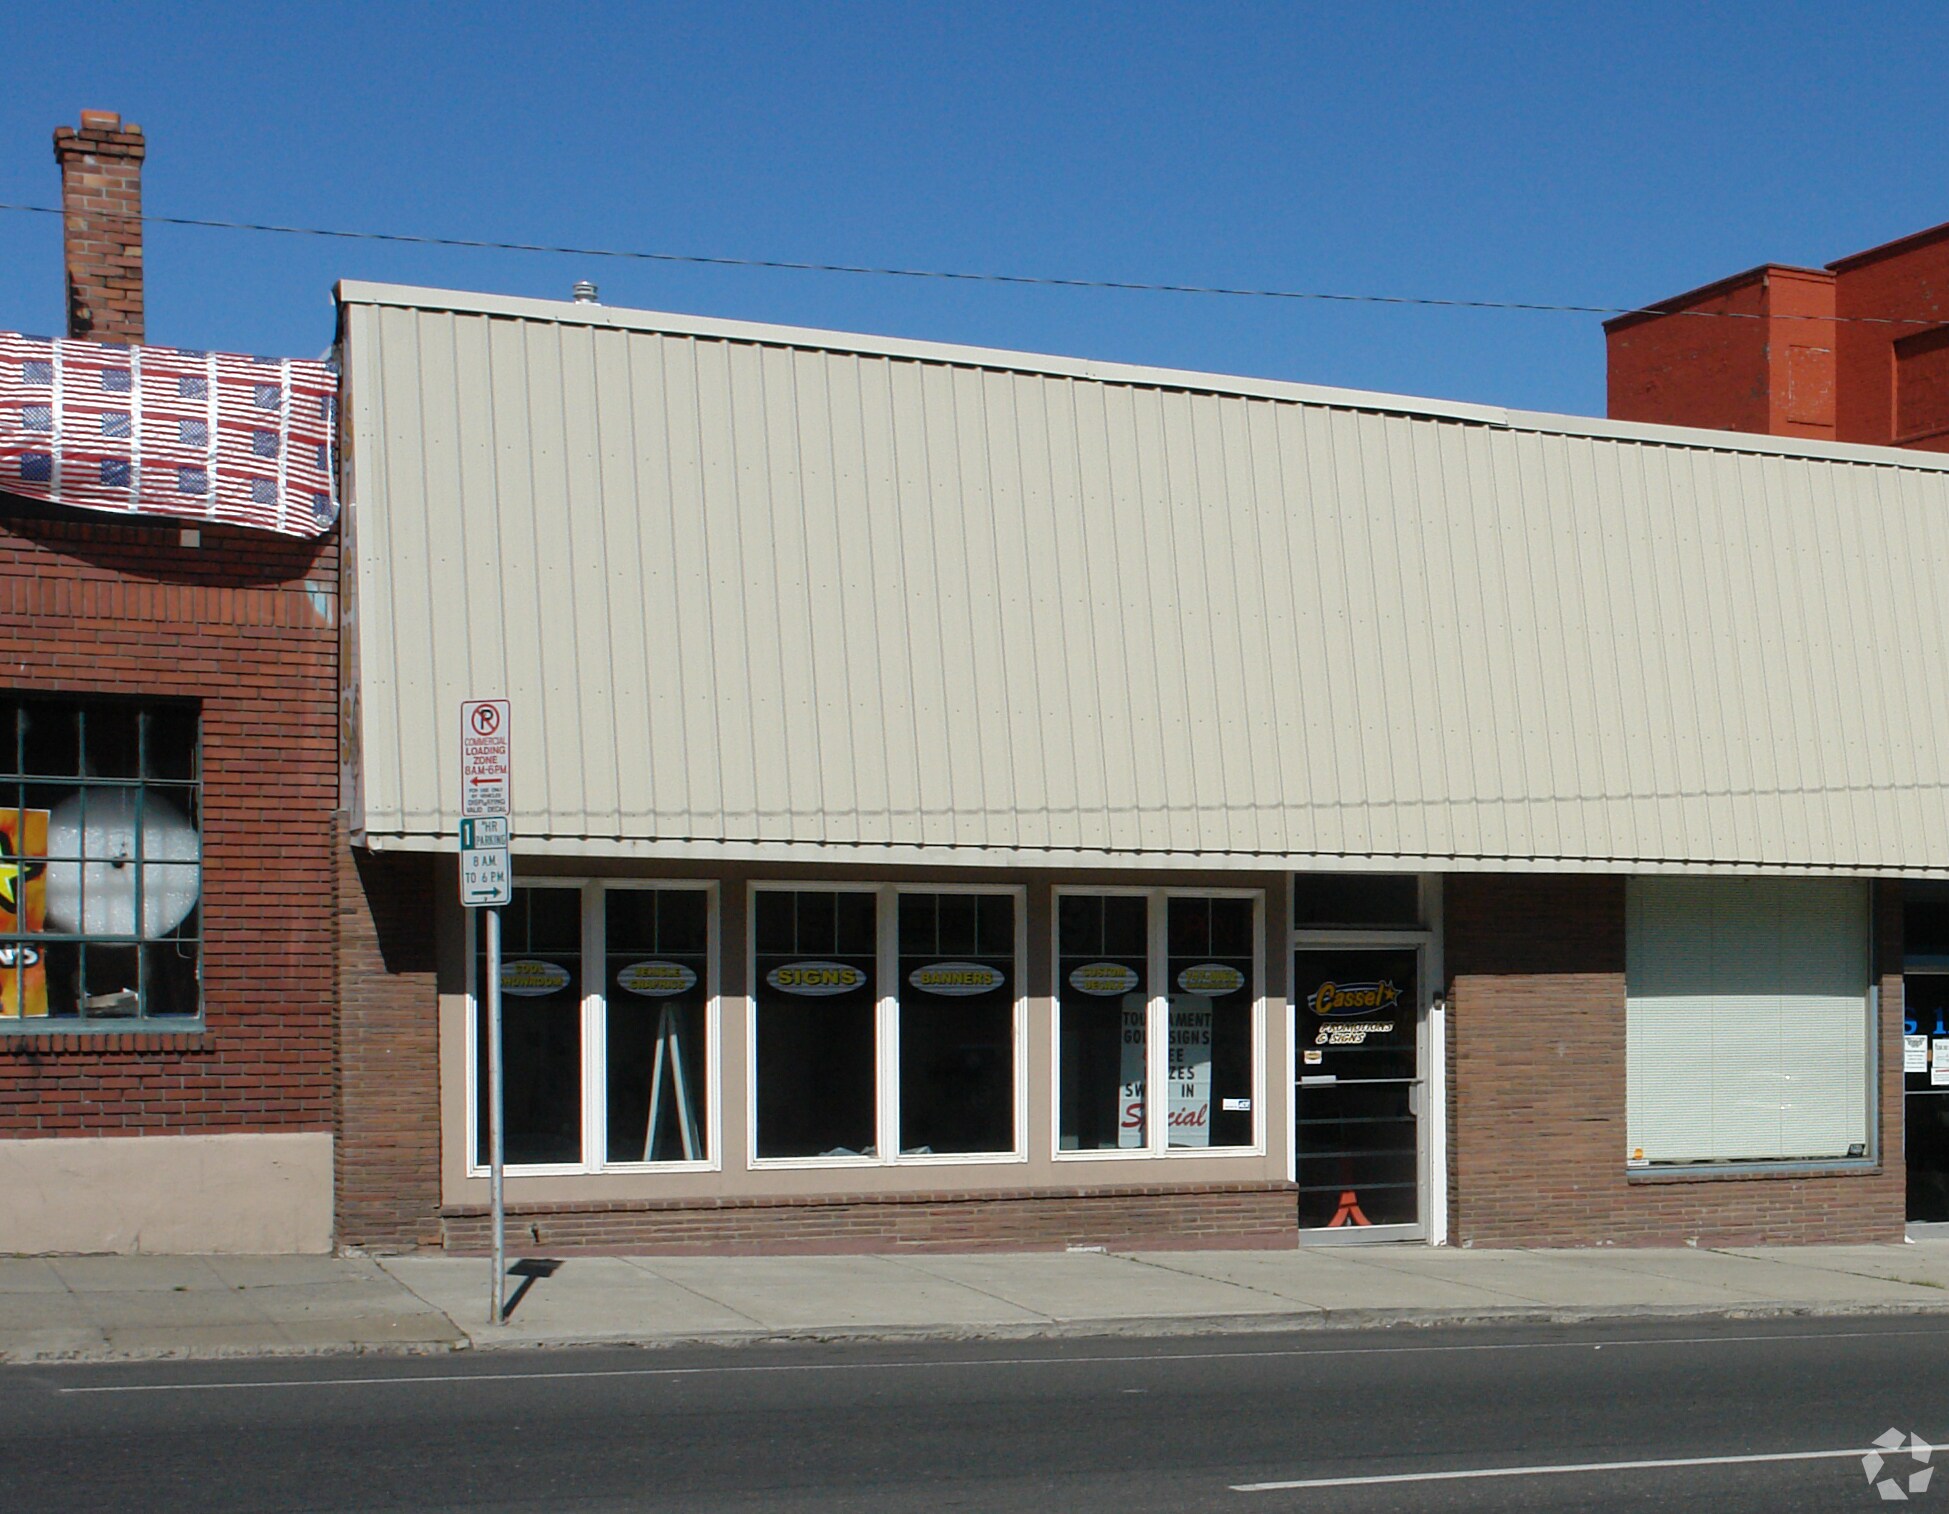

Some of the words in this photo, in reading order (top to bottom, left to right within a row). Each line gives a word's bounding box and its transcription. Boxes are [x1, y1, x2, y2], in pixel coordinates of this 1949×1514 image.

[465, 736, 507, 746] COMMERCIAL
[466, 746, 506, 756] LOADING
[473, 756, 498, 765] ZONE
[485, 820, 498, 833] HR
[463, 824, 471, 847] 1
[475, 834, 506, 847] PARKING
[473, 855, 480, 868] 8
[465, 872, 477, 884] TO
[482, 872, 488, 884] 6
[776, 967, 859, 987] SIGNS
[1083, 966, 1128, 978] CUSTOM
[629, 978, 687, 990] GRAPHICS
[920, 971, 994, 987] BANNERS
[1314, 981, 1386, 1014] Cassel
[1329, 1032, 1366, 1045] SIGNS
[1181, 1083, 1194, 1098] IN
